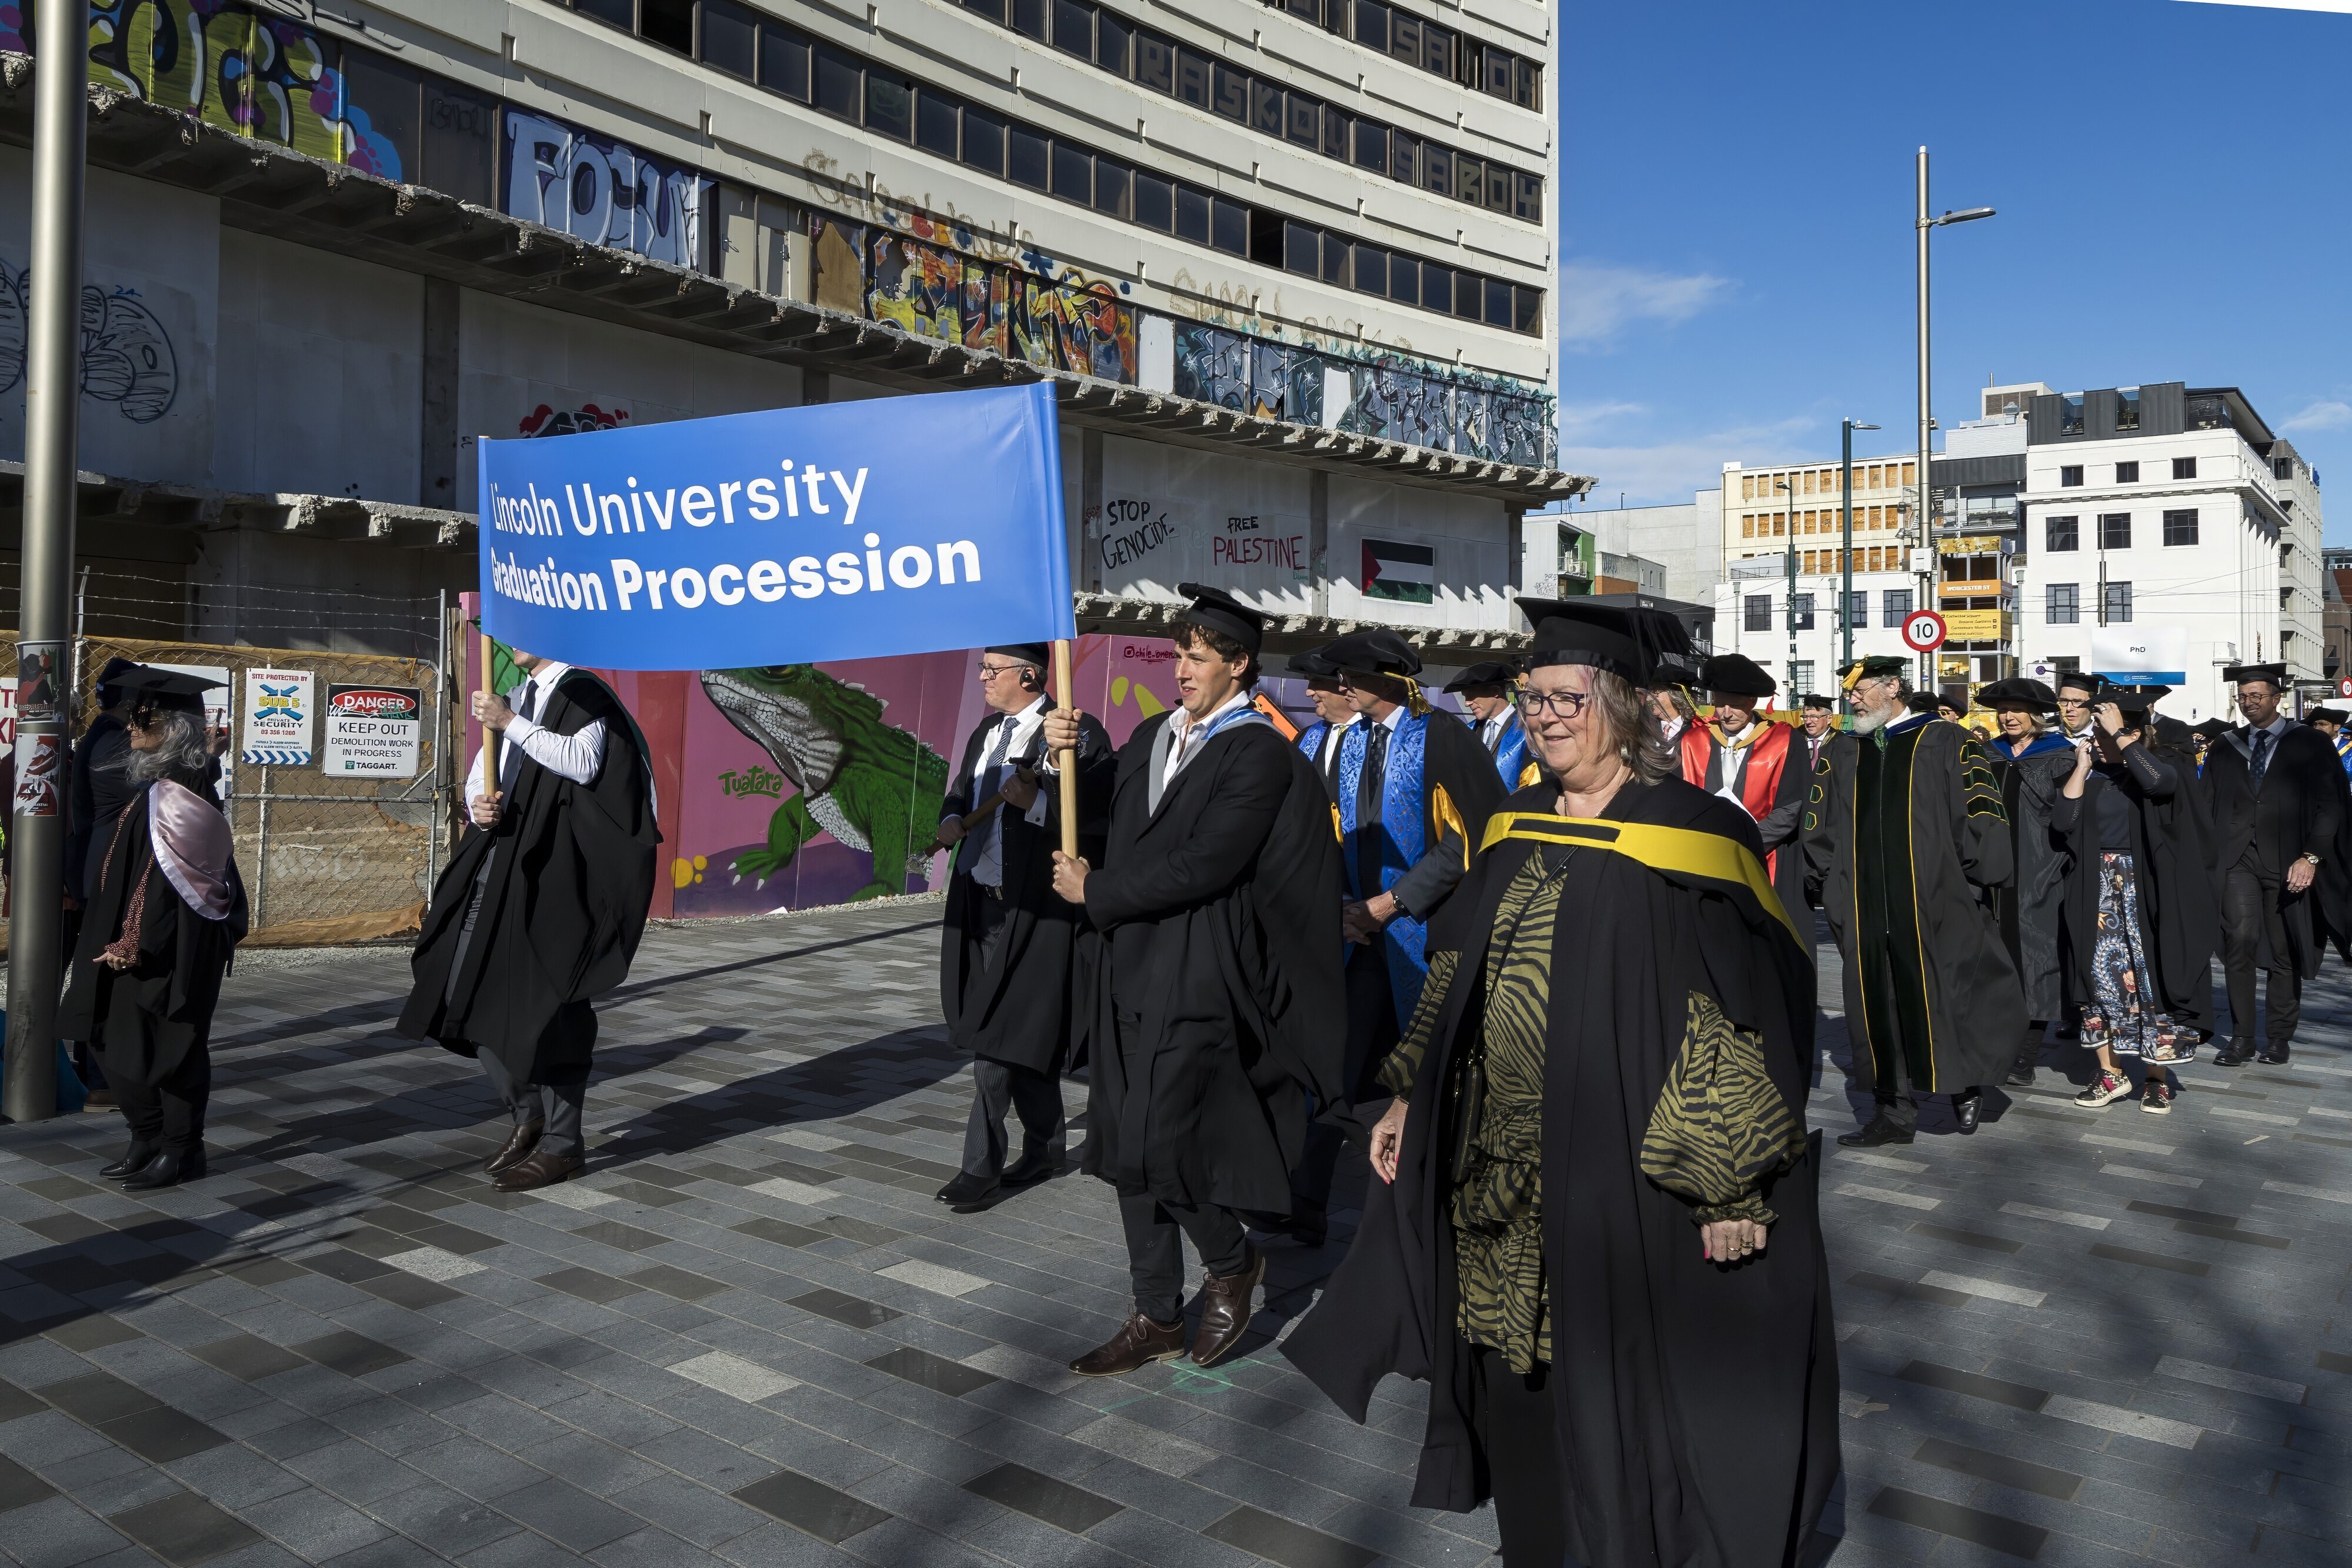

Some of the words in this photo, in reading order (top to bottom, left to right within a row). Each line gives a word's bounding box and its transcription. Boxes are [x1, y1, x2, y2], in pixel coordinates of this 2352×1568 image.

[491, 482, 563, 536] Lincoln
[565, 459, 869, 536] University
[1106, 499, 1150, 526] STOP
[1227, 516, 1259, 533] FREE
[491, 546, 608, 610] Graduation
[610, 533, 981, 610] Procession
[1915, 623, 1933, 638] 10
[2344, 684, 2350, 692] 10
[258, 696, 289, 708] SUB
[292, 698, 300, 708] 5
[344, 695, 405, 709] DANGER
[339, 722, 376, 733] KEEP
[381, 724, 409, 735] OUT
[331, 738, 386, 746] DEMOLITION
[354, 749, 402, 758] PROGRESS
